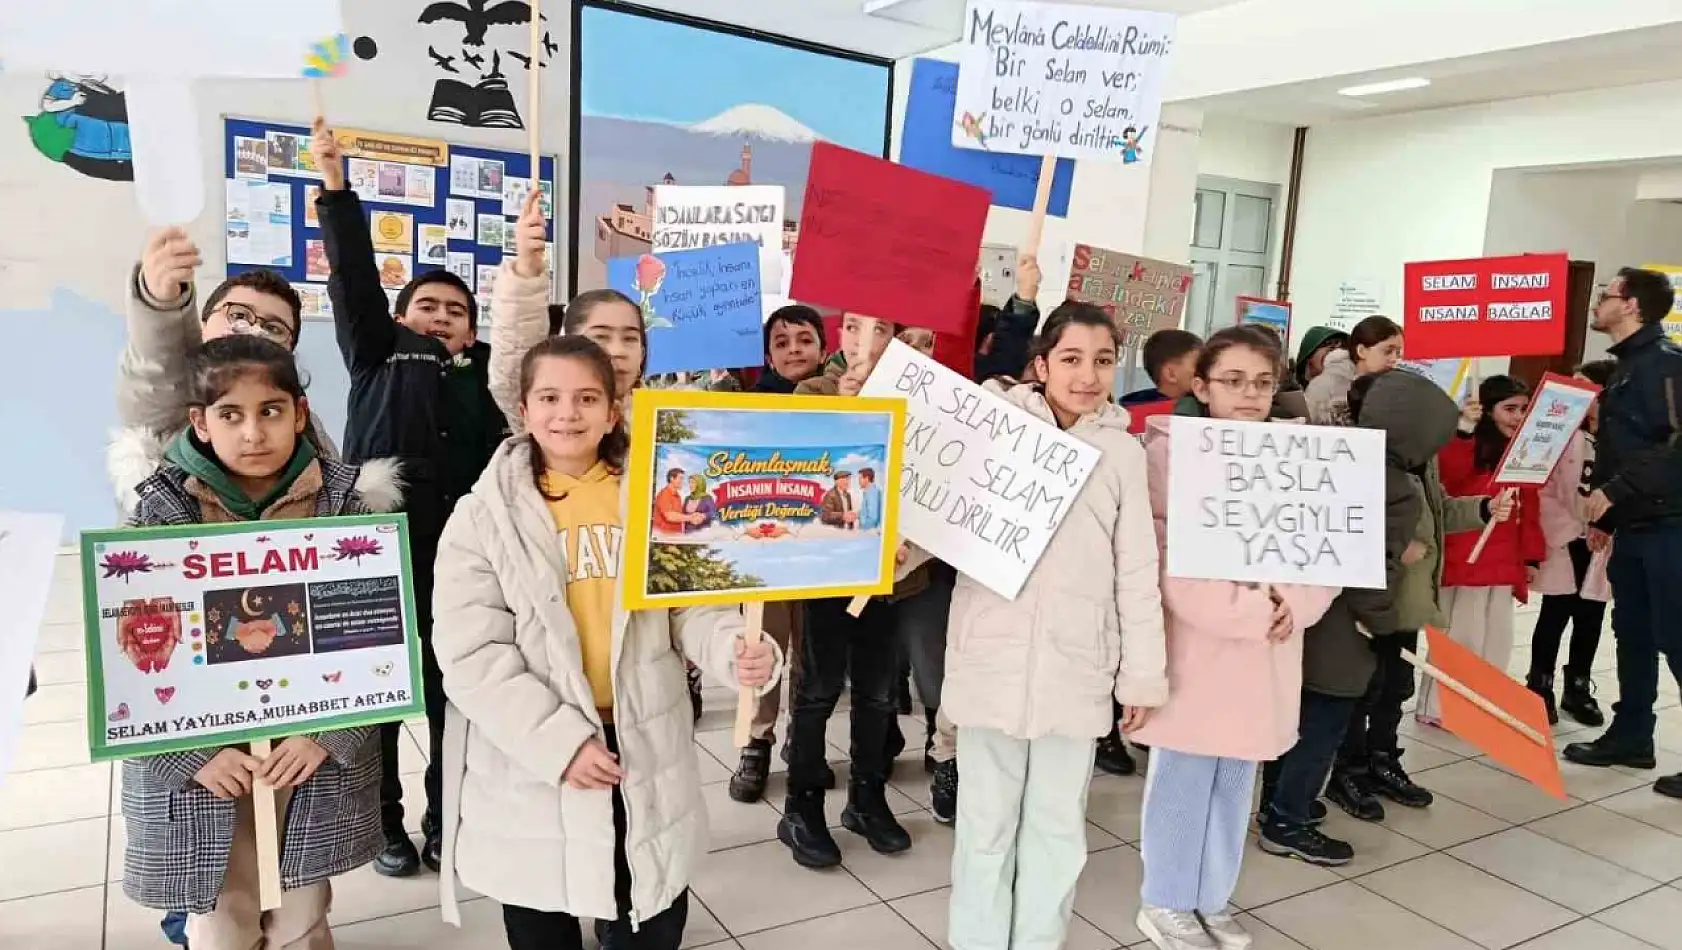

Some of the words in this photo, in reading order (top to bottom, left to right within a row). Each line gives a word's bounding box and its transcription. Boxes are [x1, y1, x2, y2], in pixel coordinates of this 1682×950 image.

[995, 45, 1026, 77] Bir
[991, 86, 1041, 115] belki
[989, 115, 1016, 138] bir
[1424, 275, 1475, 289] SELAM
[1487, 303, 1551, 320] BAĞLAR
[939, 386, 1027, 451] SELAM
[937, 440, 966, 467] O
[1199, 425, 1356, 462] SELAMLA
[719, 504, 762, 522] Verdiği
[183, 546, 319, 580] SELAM
[1236, 531, 1342, 571] YAŞA
[107, 719, 167, 740] SELAM
[353, 689, 410, 707] ARTAR.
